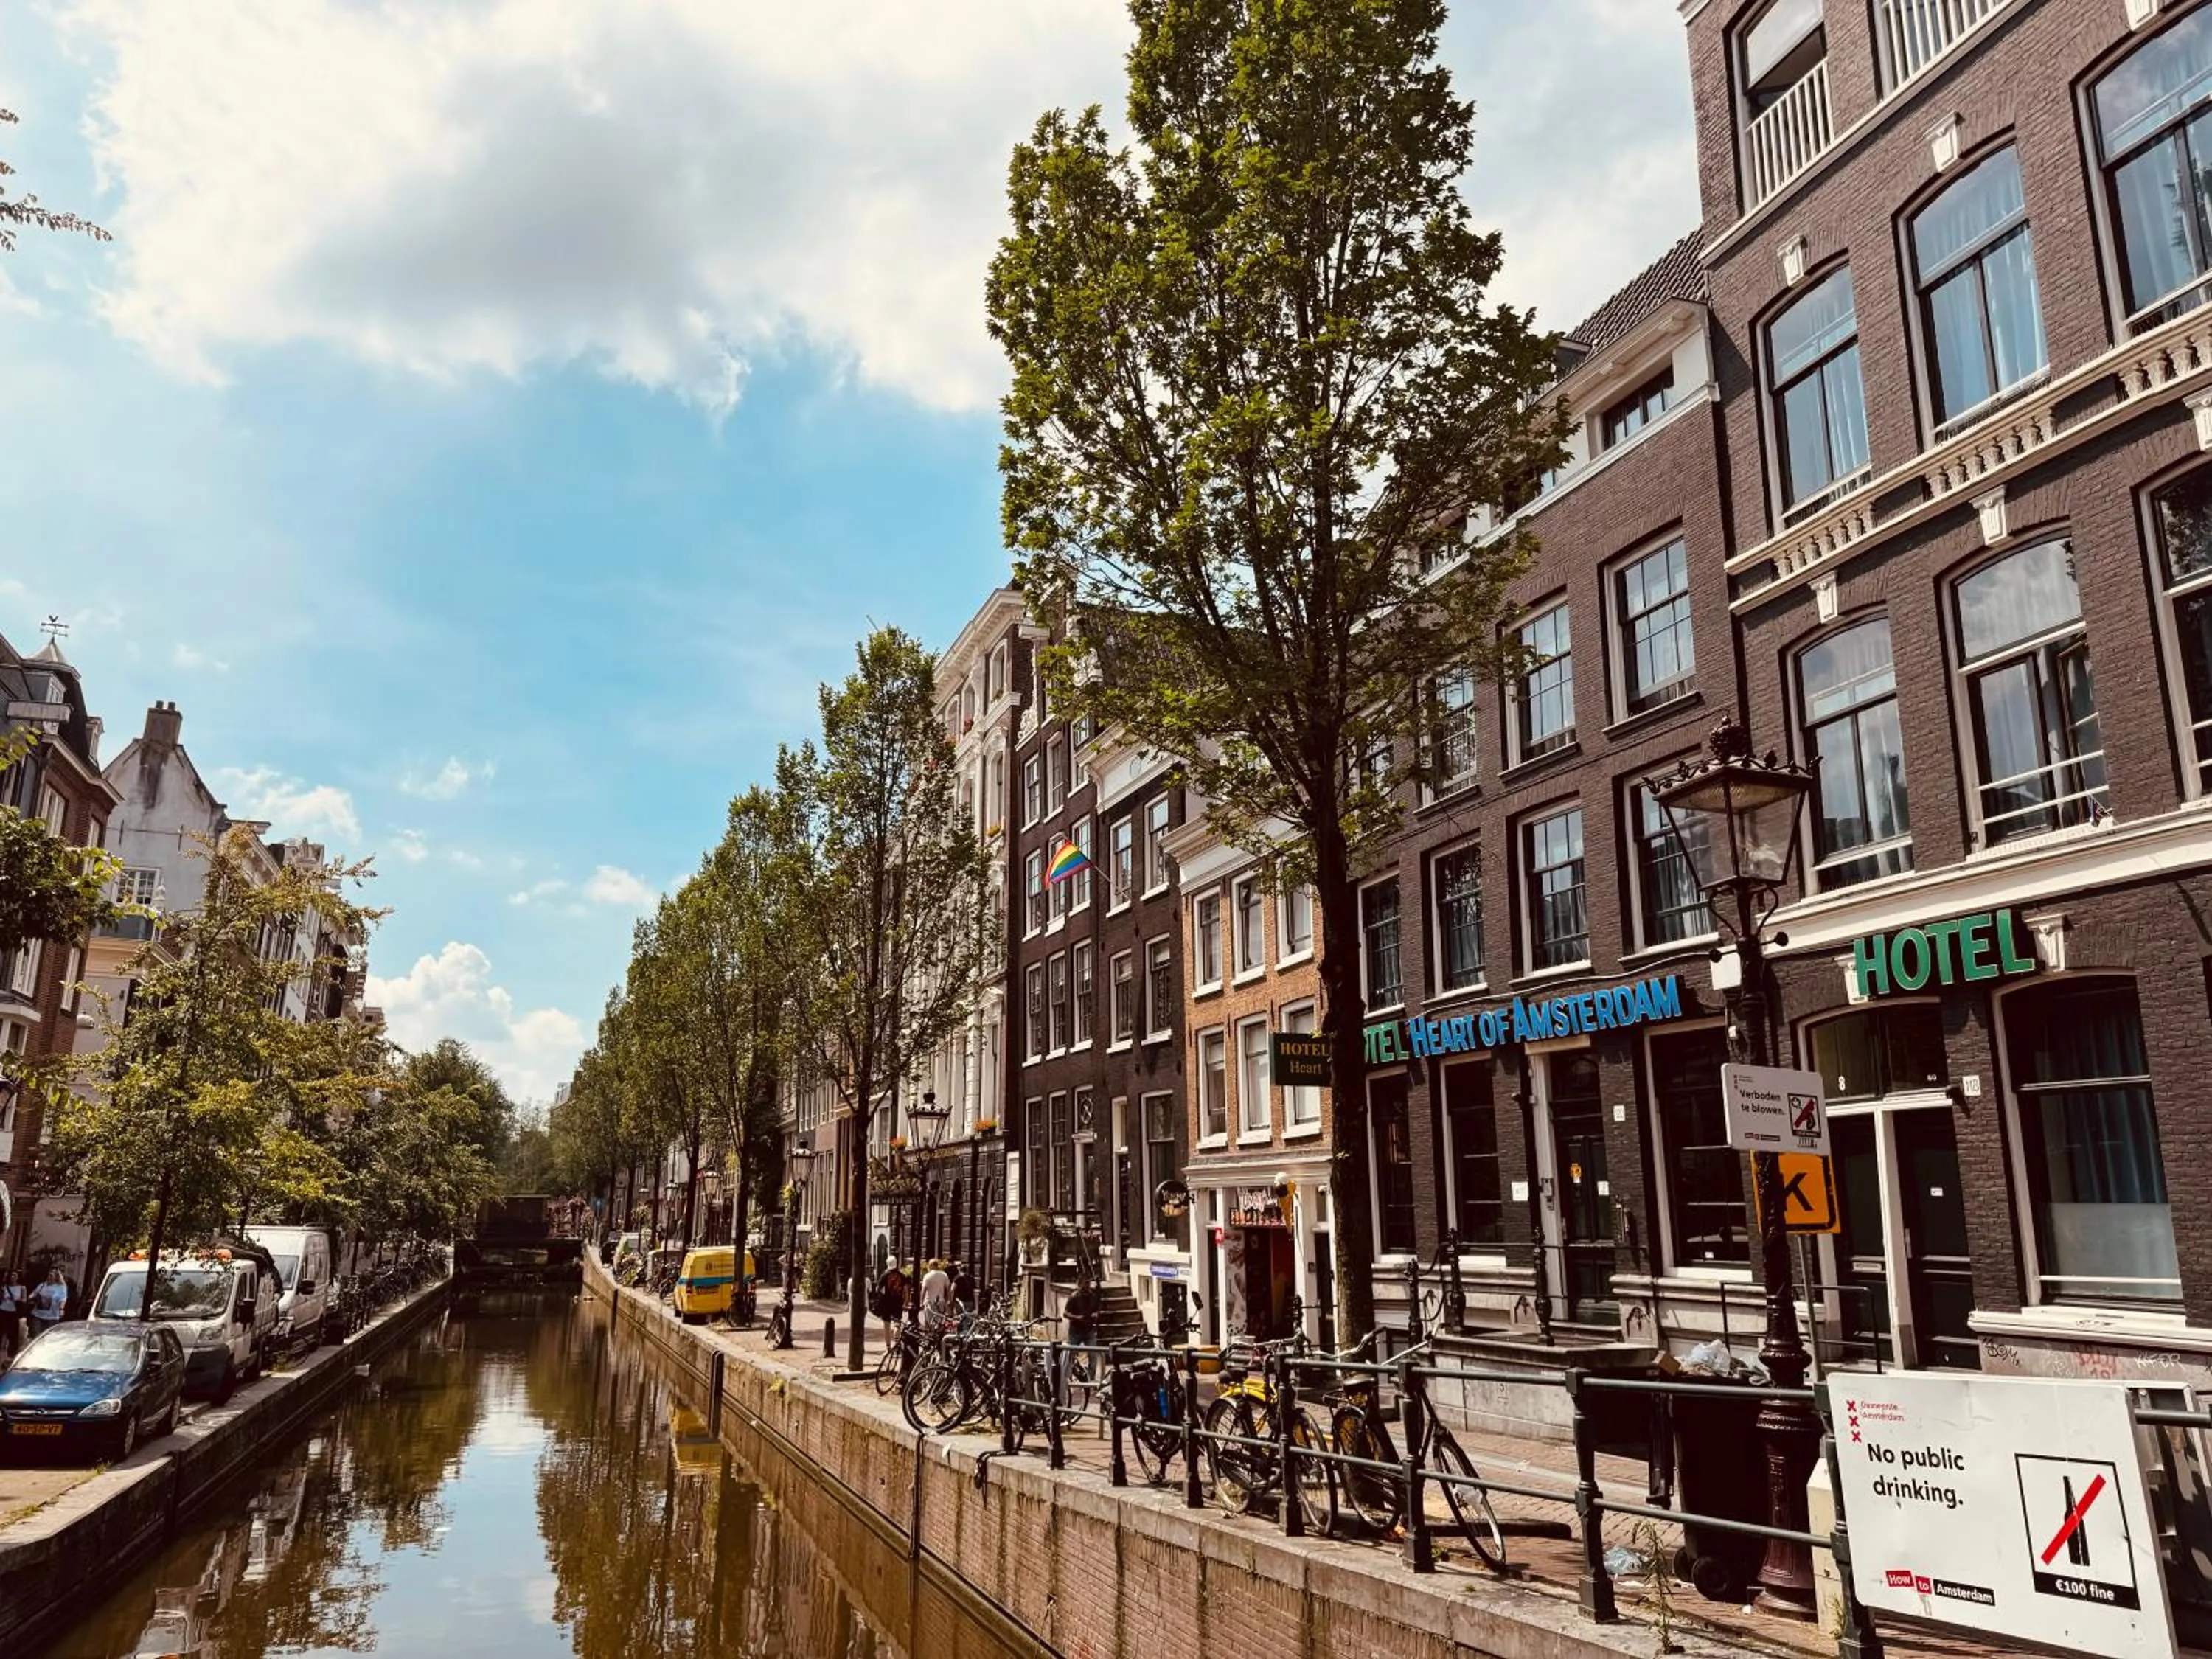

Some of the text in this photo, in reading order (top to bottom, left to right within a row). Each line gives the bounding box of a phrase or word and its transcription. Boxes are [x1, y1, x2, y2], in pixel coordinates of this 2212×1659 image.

[1853, 908, 2036, 998] HOTEL
[1363, 974, 1683, 1065] TEL HEART OF AMSTERDAM
[1280, 1042, 1330, 1057] HOTEL
[1290, 1061, 1323, 1074] Heart
[1739, 1089, 1781, 1101] Verboden
[1741, 1103, 1786, 1116] te blowen.
[1867, 1443, 1965, 1471] No public
[1873, 1474, 1964, 1509] drinking.
[1888, 1574, 1993, 1604] How to Amsterdam
[2055, 1578, 2115, 1601] €100 fine
